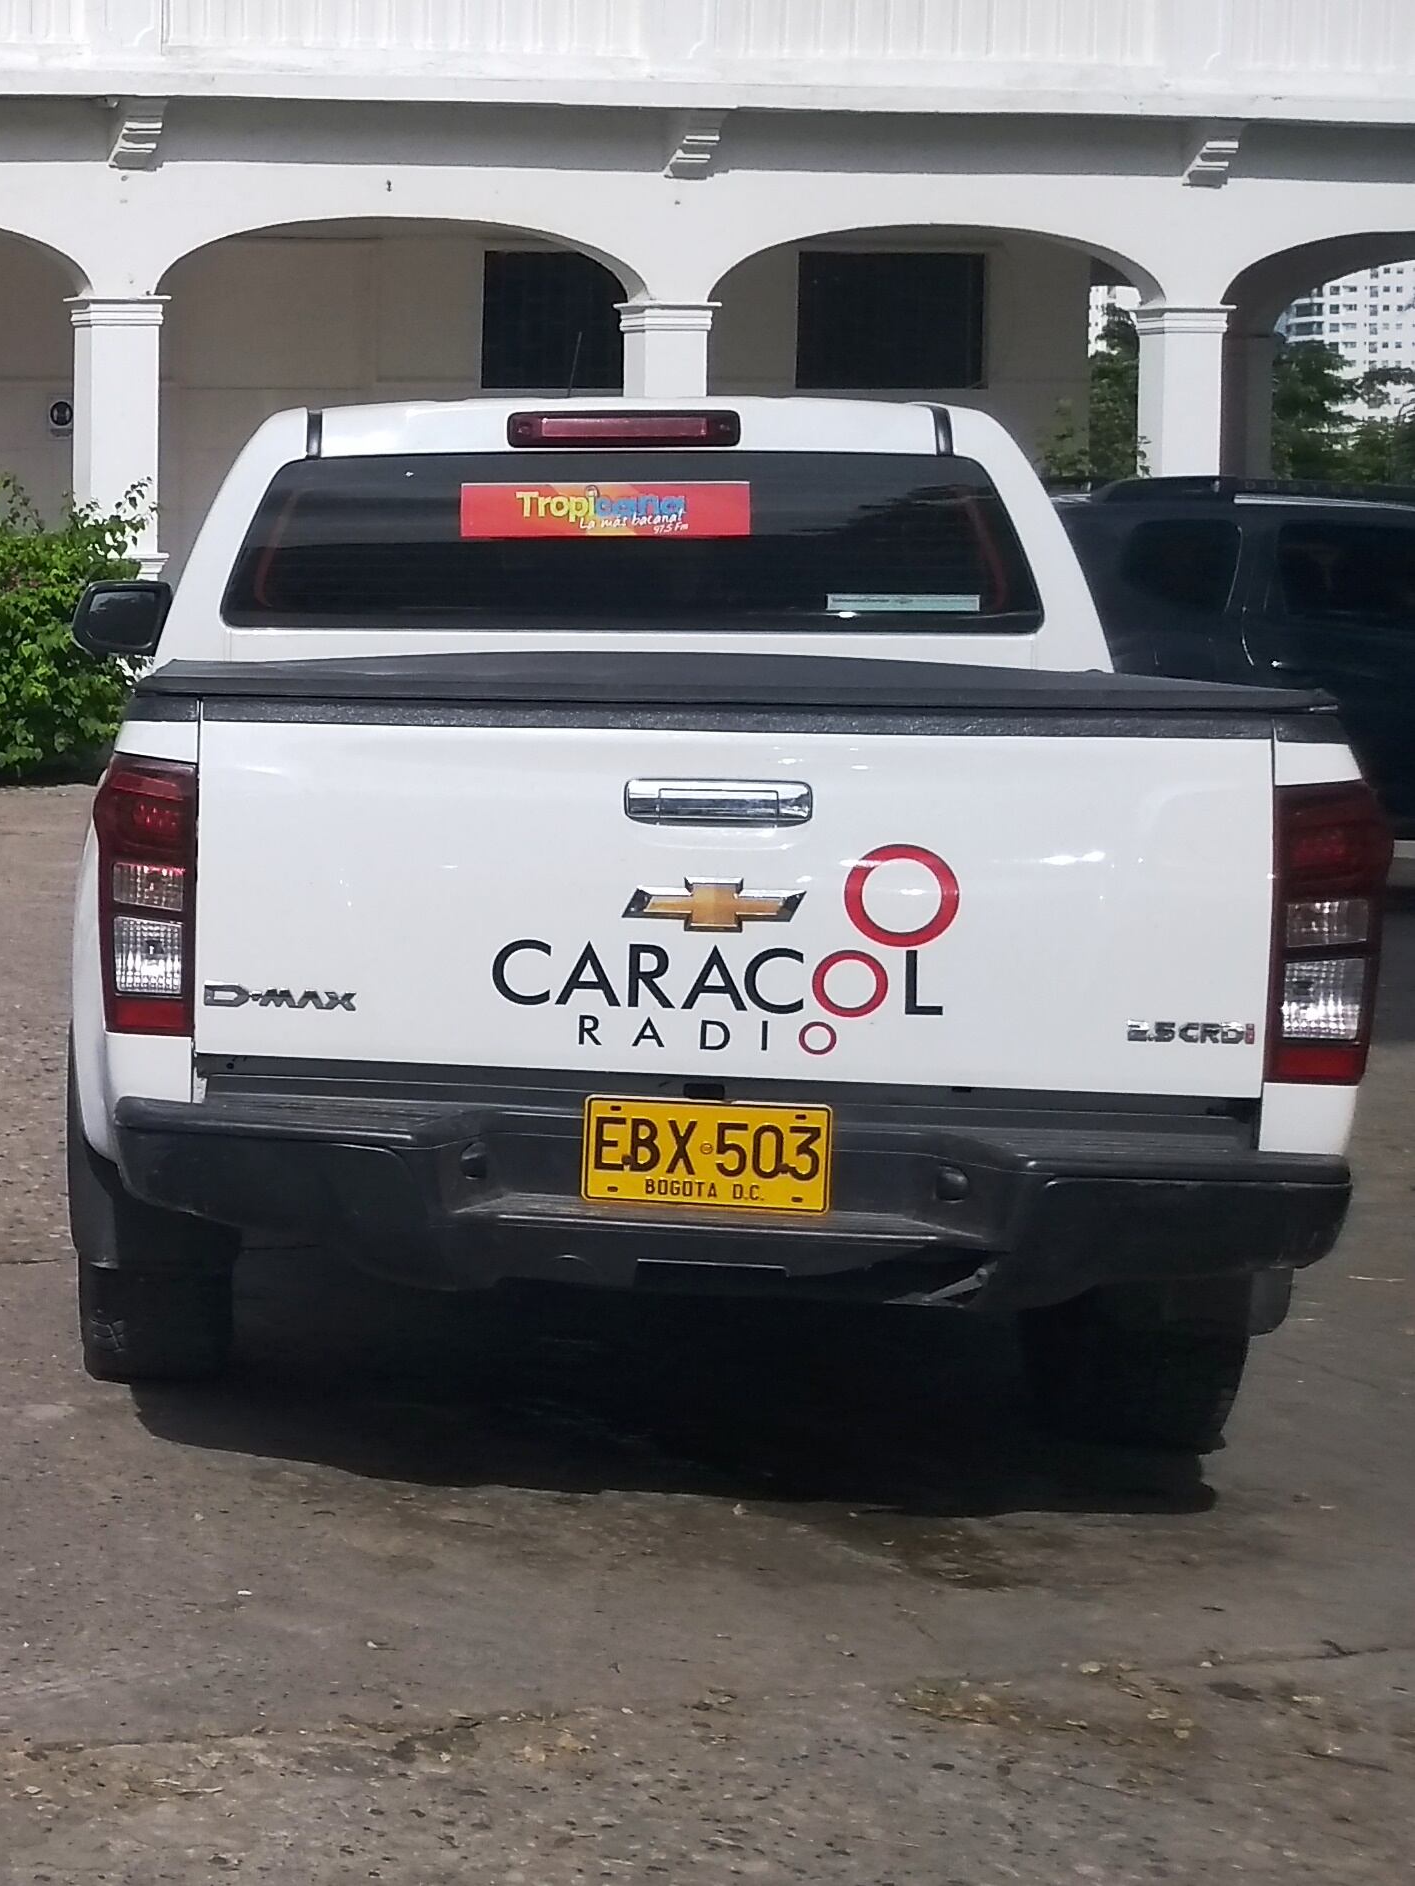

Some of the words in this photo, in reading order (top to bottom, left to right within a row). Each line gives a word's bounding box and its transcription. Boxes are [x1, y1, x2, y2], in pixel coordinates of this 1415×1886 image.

[515, 485, 686, 522] Tropicana
[580, 517, 595, 530] La
[204, 980, 356, 1011] D-MAX
[492, 939, 944, 1019] CARACOL
[577, 1014, 837, 1056] RADIO
[593, 1116, 699, 1176] EBX
[715, 1122, 822, 1181] 503
[644, 1178, 718, 1198] BOGOTA
